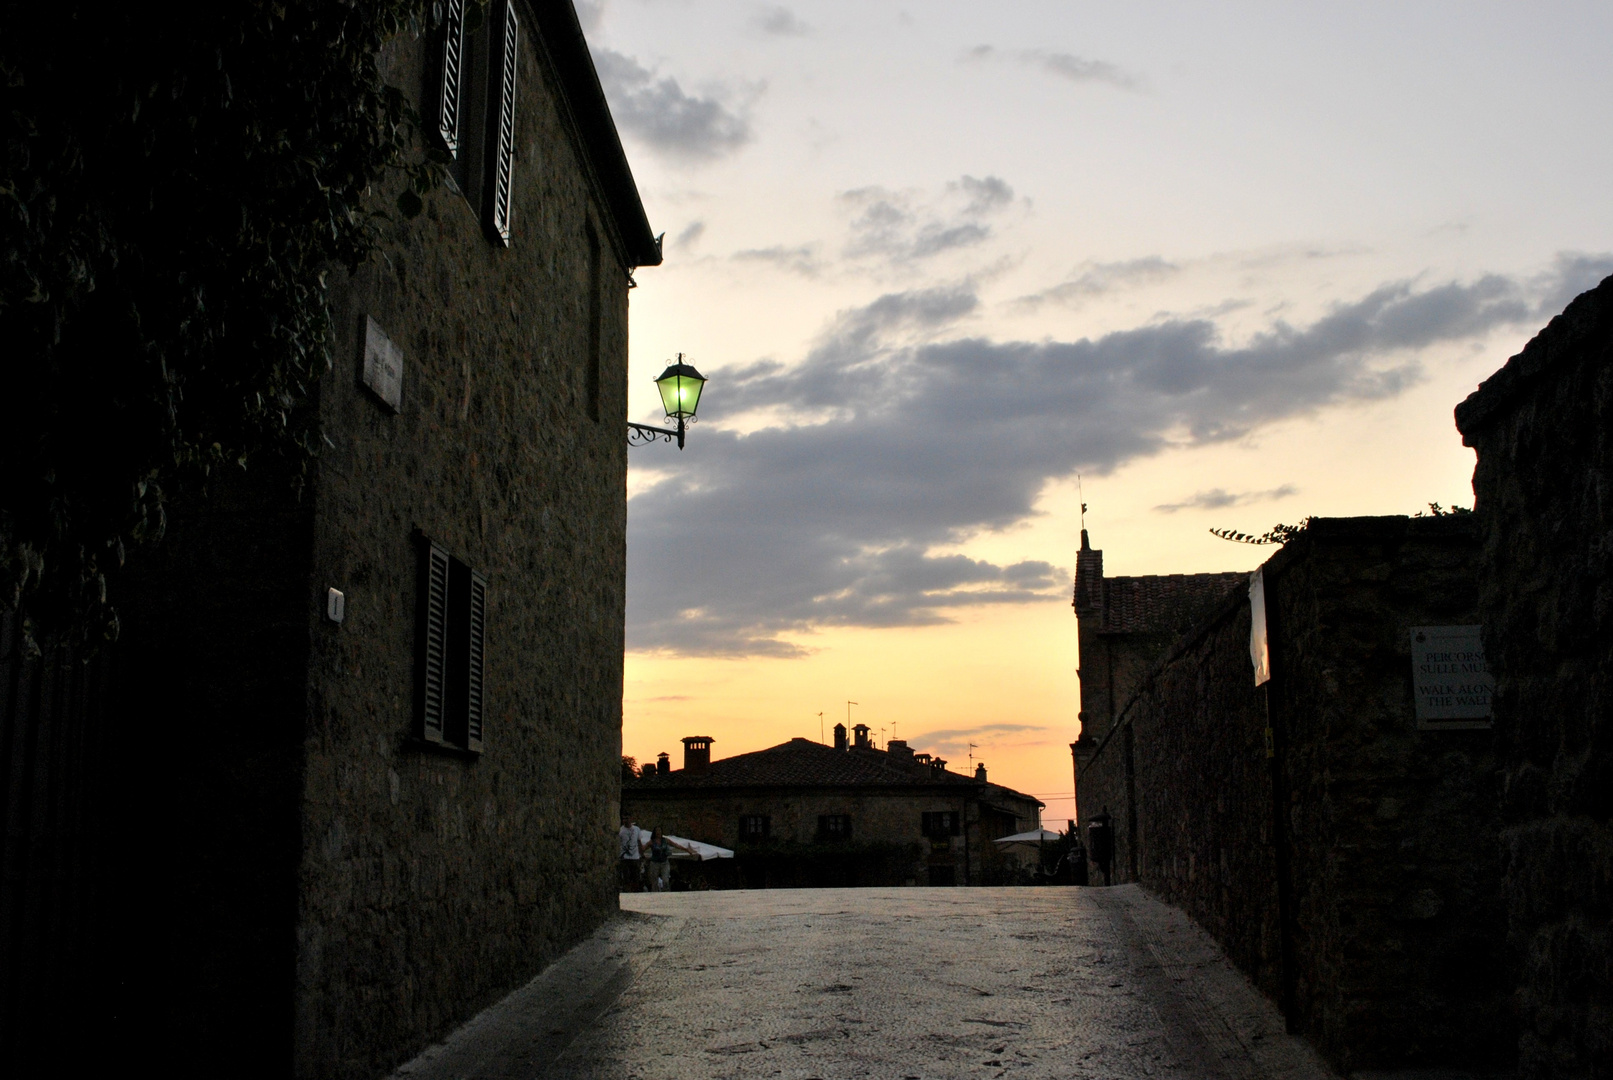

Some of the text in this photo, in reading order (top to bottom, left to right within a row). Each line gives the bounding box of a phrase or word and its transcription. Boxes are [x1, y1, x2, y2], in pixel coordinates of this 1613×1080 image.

[1420, 663, 1458, 673] SULLE
[1419, 685, 1455, 695] WALK
[1429, 696, 1452, 706] THE
